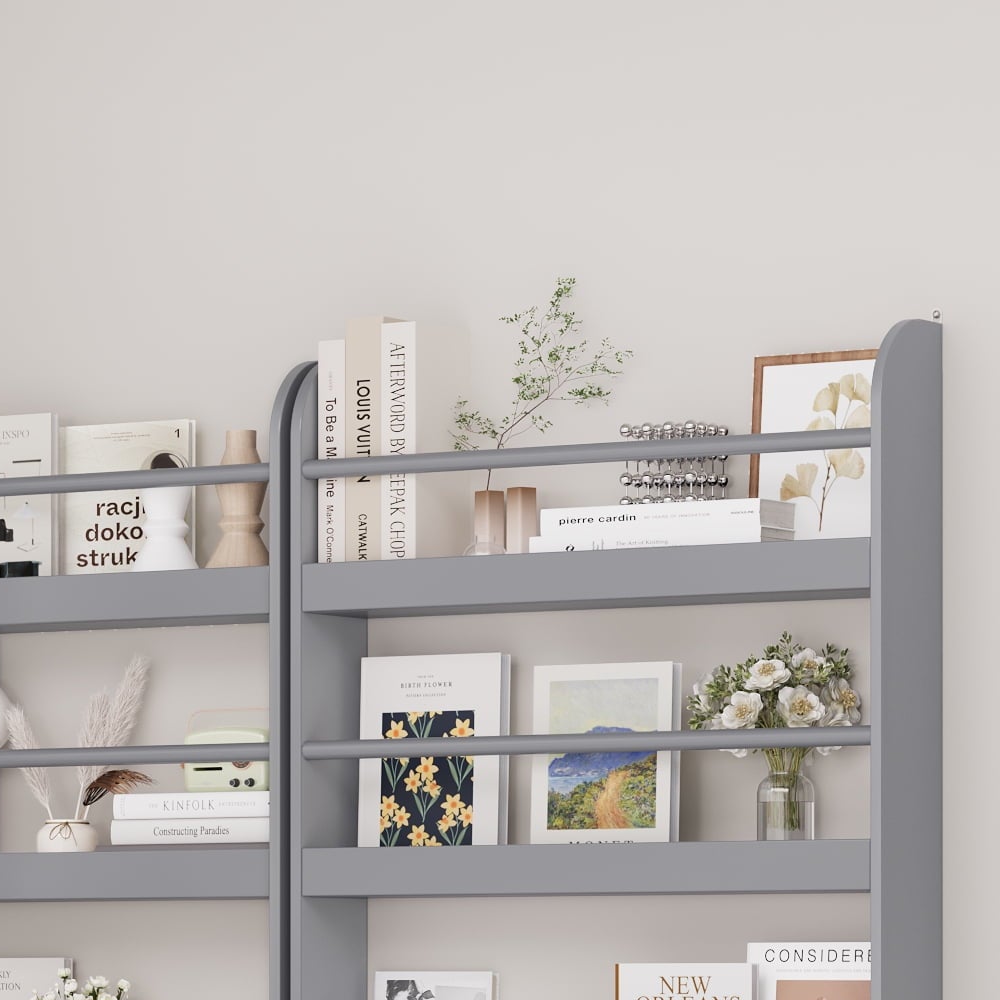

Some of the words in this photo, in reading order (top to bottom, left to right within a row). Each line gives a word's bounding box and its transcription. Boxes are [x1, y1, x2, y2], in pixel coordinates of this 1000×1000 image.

[389, 342, 406, 433] AFTERWORD
[325, 397, 337, 412] To
[356, 379, 371, 421] LOUIS
[325, 415, 337, 432] Be
[2, 429, 30, 440] INSPO
[174, 428, 180, 439] 1
[325, 435, 335, 443] a
[356, 423, 371, 483] VUITN
[389, 438, 406, 456] BY
[96, 496, 146, 519] racj
[559, 516, 594, 526] pierre
[598, 514, 637, 523] cardin
[358, 513, 368, 561] CATWALK
[163, 800, 215, 812] KINFOLK
[153, 826, 198, 838] Constructing
[200, 825, 230, 836] Paradies
[659, 975, 712, 995] NEW
